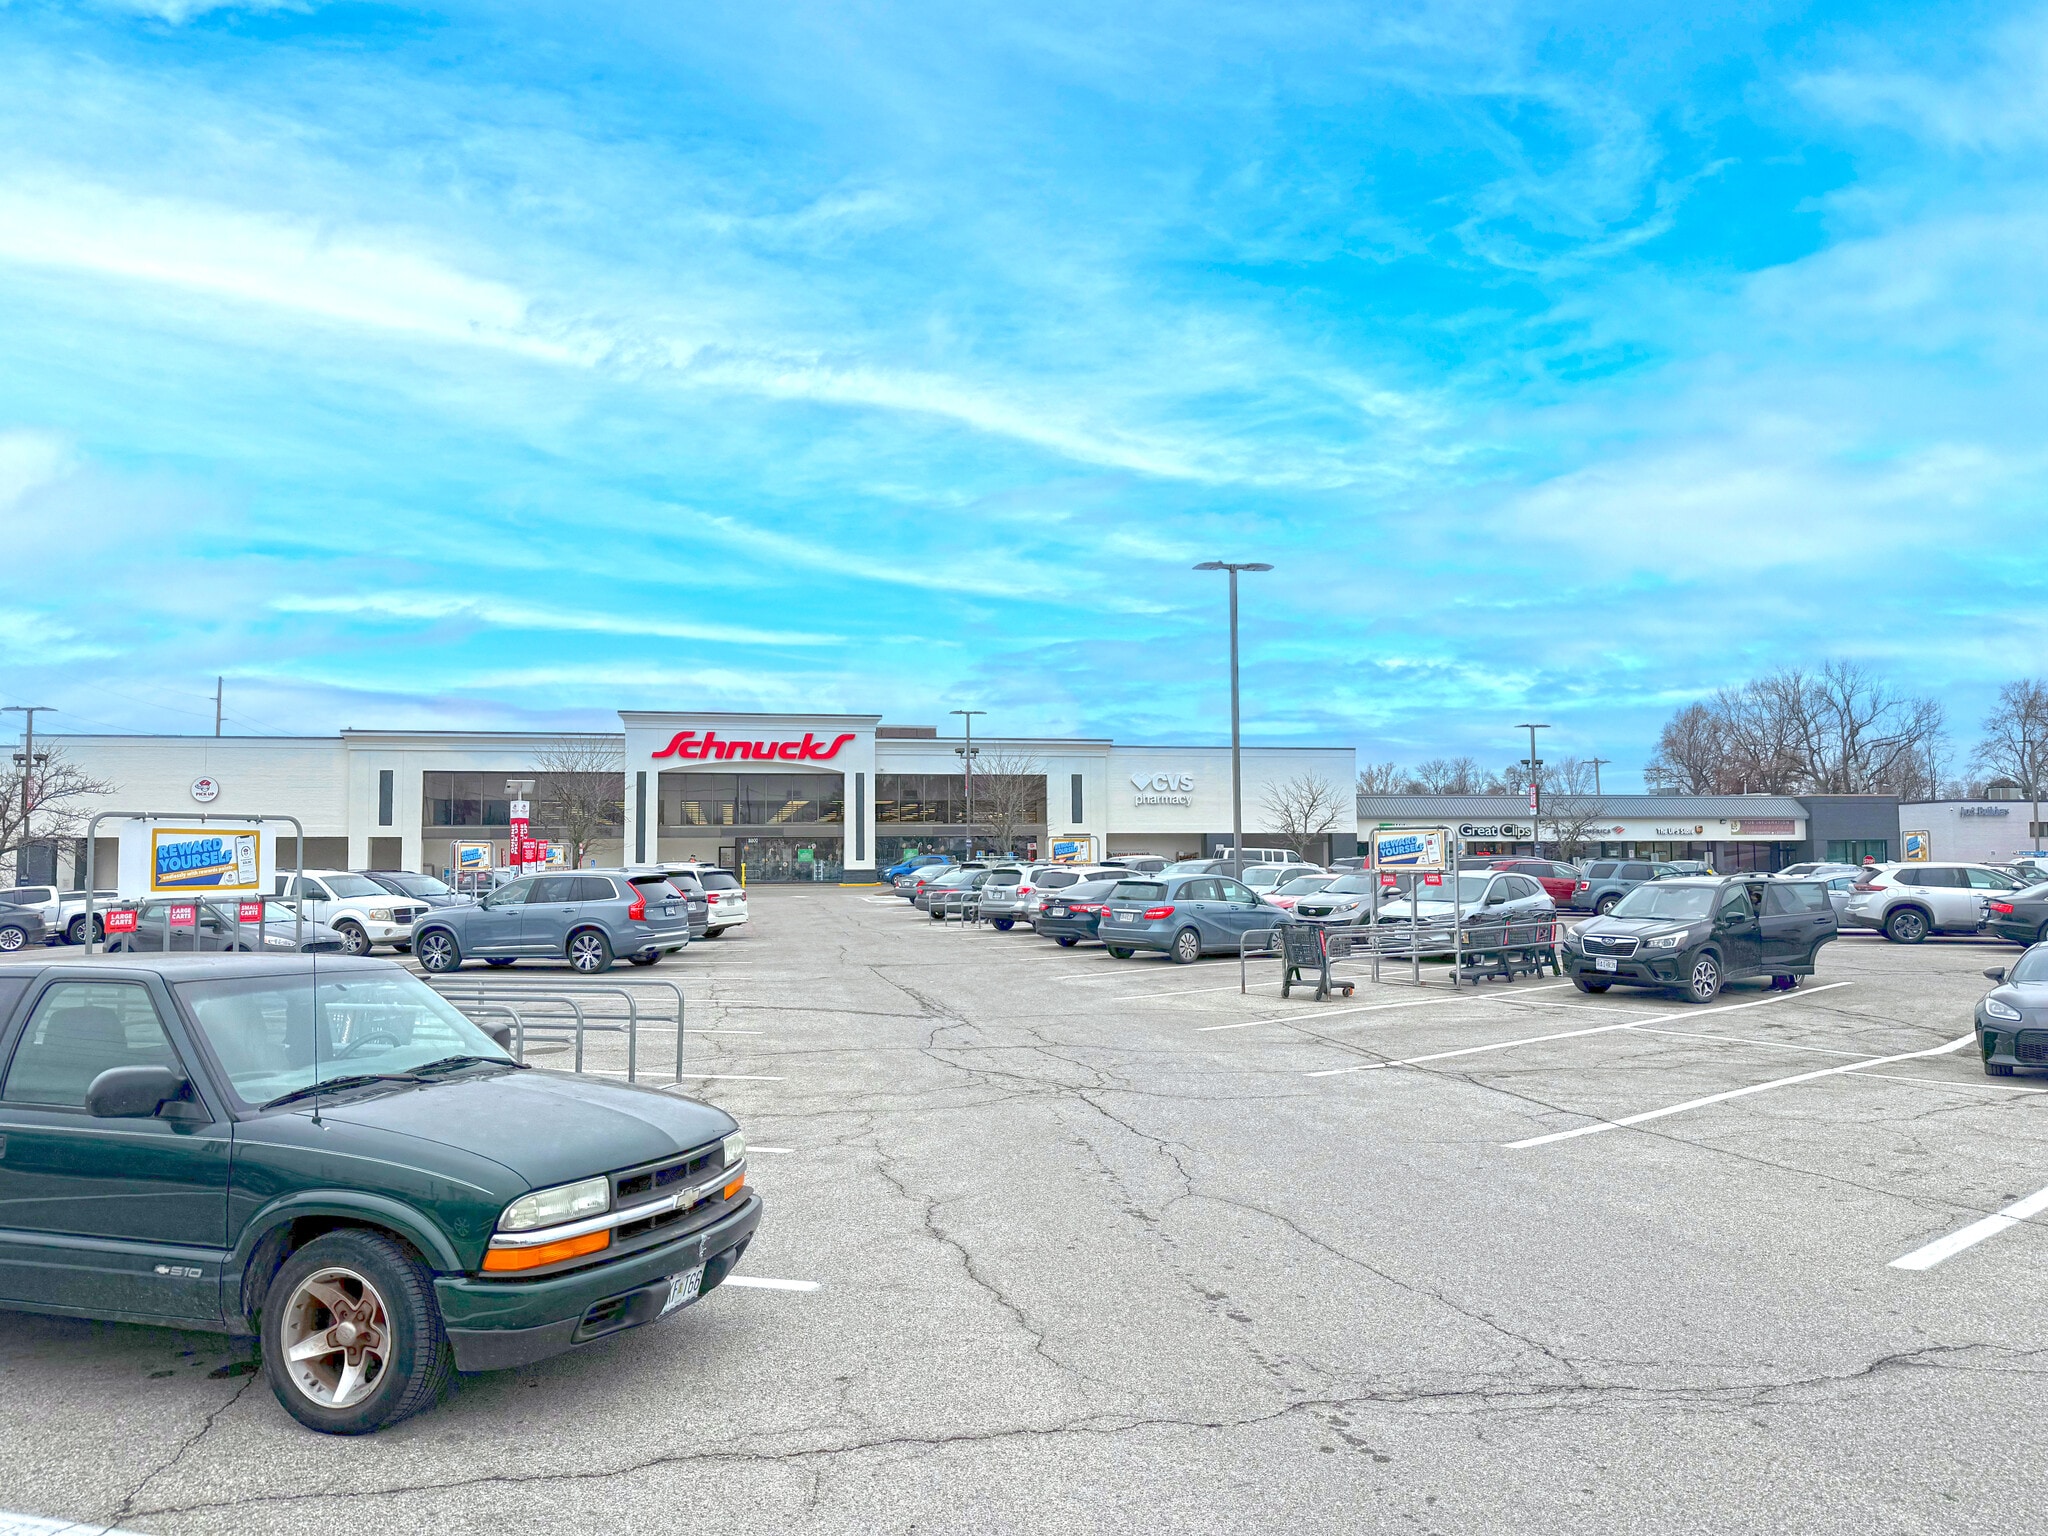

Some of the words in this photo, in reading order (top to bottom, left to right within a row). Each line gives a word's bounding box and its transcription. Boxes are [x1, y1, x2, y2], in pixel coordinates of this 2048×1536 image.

[1151, 773, 1194, 792] CVS
[1135, 793, 1192, 807] pharmacy
[1459, 823, 1498, 837] Great
[1500, 823, 1532, 839] Clips
[158, 838, 223, 858] REWARD
[1380, 836, 1418, 849] REWARD
[1380, 843, 1424, 856] YOURSELF
[158, 849, 233, 872] YOURSELF
[170, 1266, 202, 1278] S10
